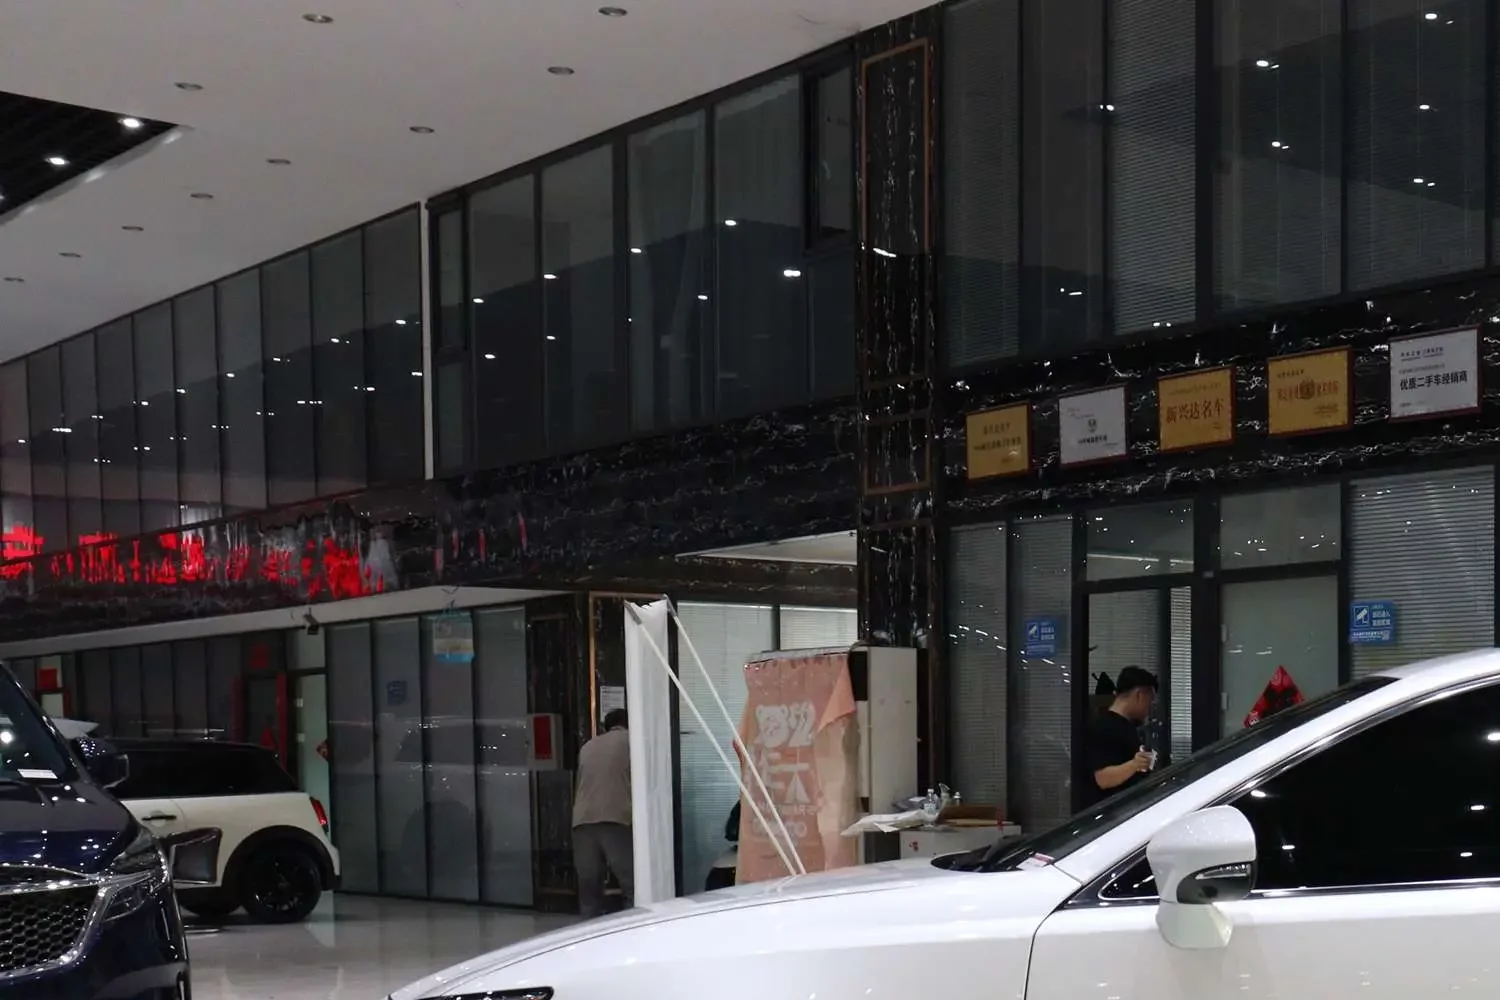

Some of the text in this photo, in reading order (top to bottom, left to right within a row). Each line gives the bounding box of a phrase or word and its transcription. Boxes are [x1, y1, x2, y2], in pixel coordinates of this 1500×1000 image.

[1400, 370, 1468, 391] 优质二手车经销商
